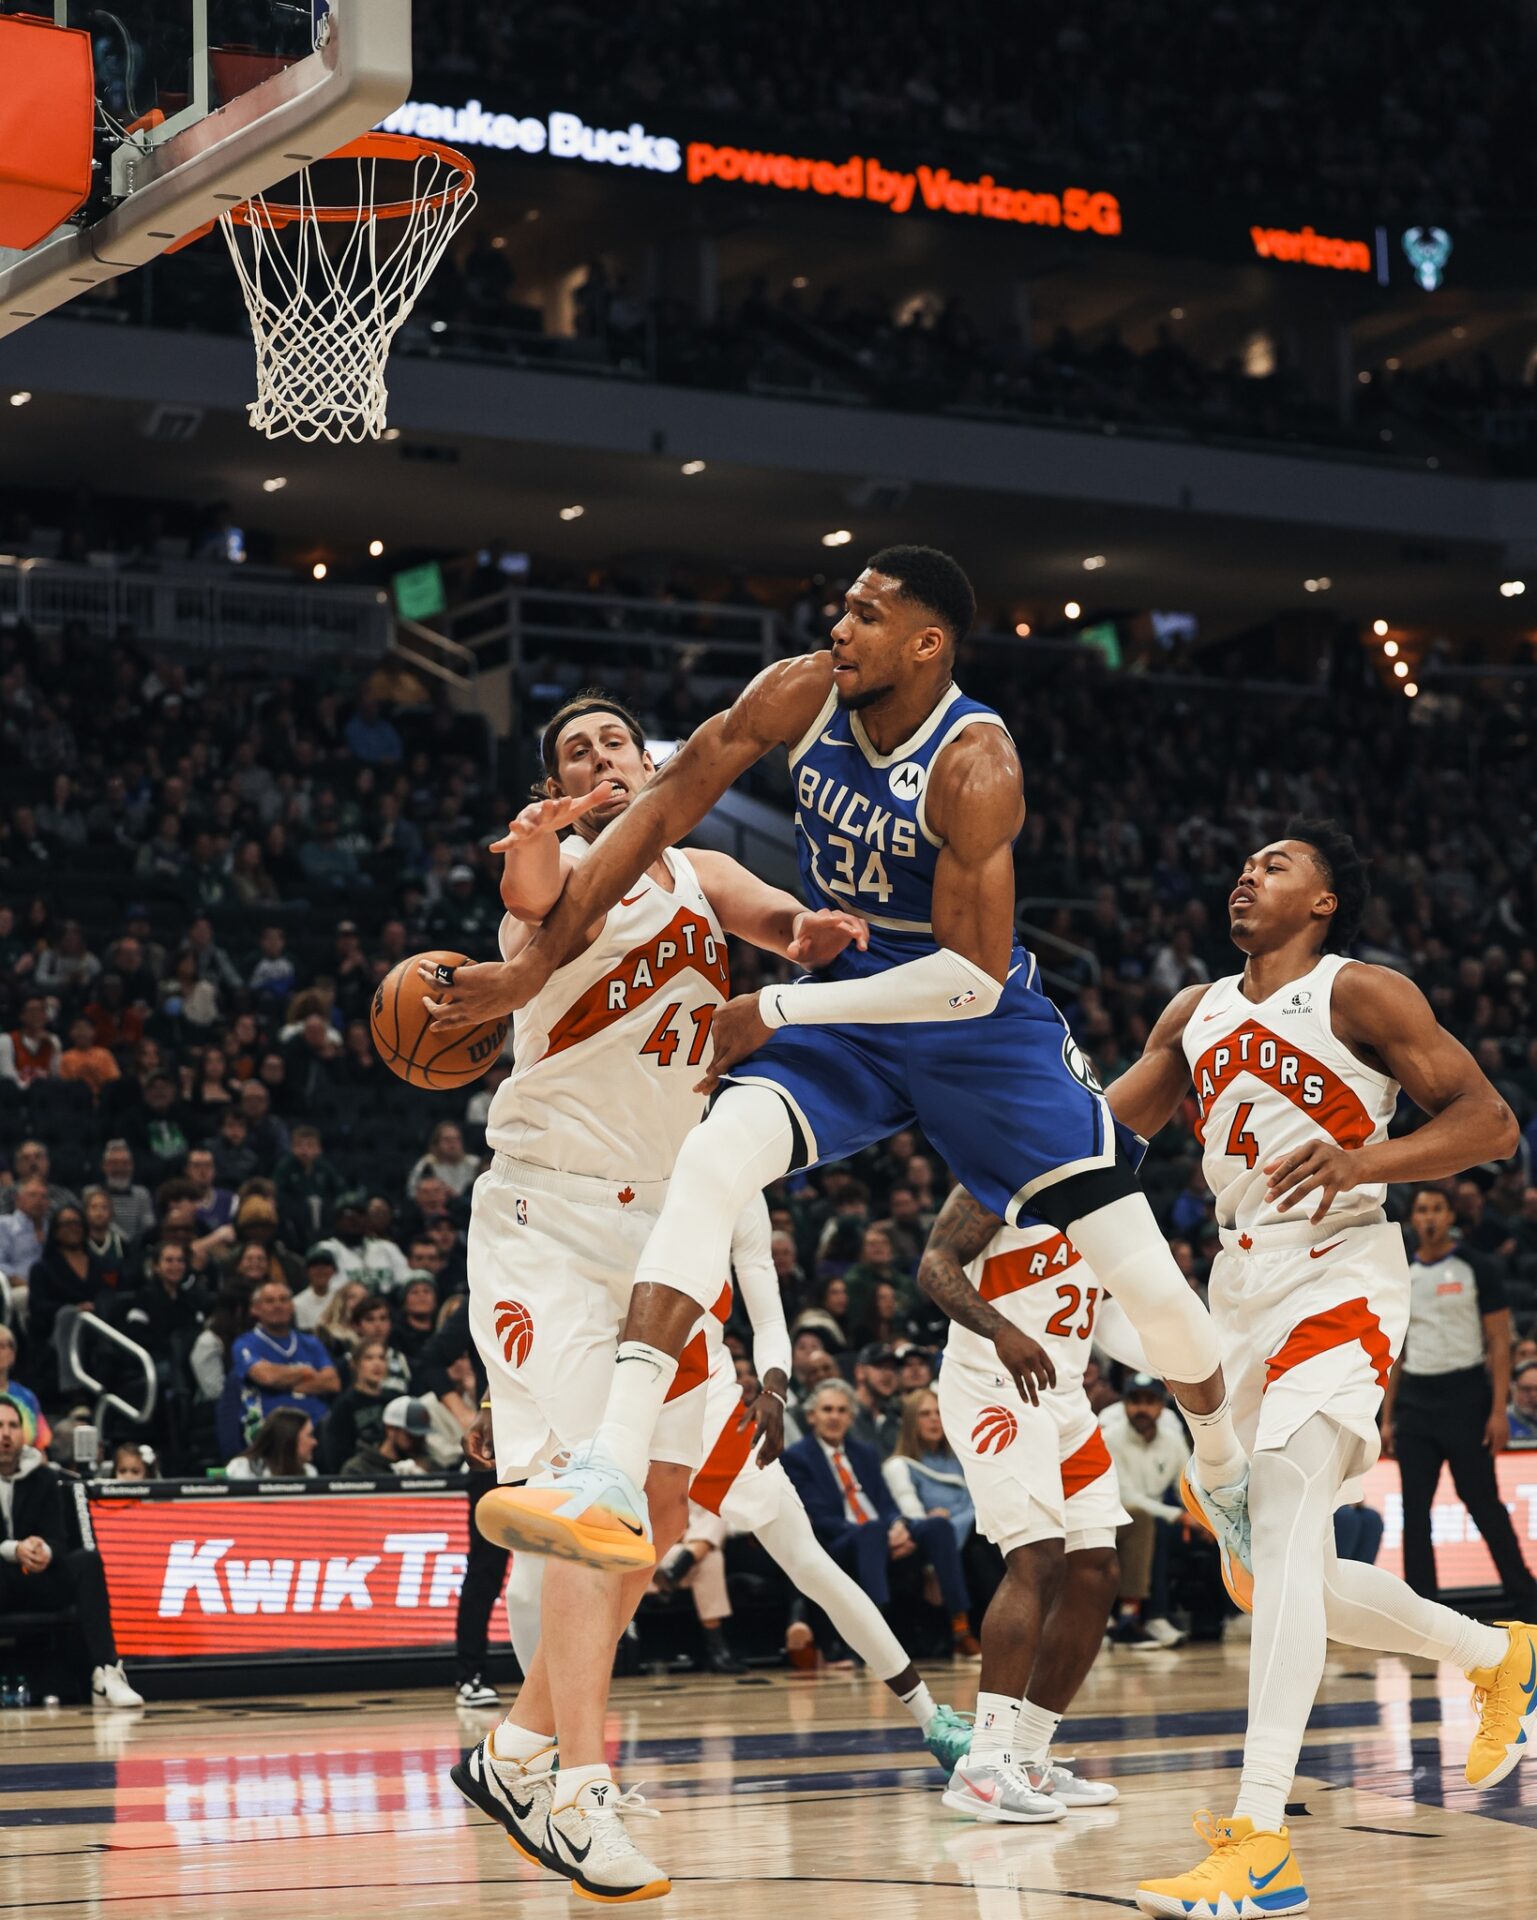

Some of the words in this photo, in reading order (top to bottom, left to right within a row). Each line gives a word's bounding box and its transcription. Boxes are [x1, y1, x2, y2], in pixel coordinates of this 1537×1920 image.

[371, 99, 547, 153] waukee
[549, 111, 682, 172] Bucks
[687, 142, 864, 198] powered
[866, 158, 916, 212] by
[916, 166, 1061, 227] Verizon
[1062, 188, 1122, 235] 5G
[1250, 226, 1370, 272] verizon
[798, 765, 917, 857] BUCKS
[828, 834, 894, 903] 34
[608, 923, 727, 1010] RAPTO
[639, 1002, 718, 1067] 41
[1281, 1008, 1297, 1016] Sun
[1297, 1005, 1313, 1014] Life
[1225, 1103, 1260, 1170] 4
[1028, 1242, 1077, 1277] RA
[1045, 1284, 1098, 1340] 23
[383, 1532, 469, 1608] TR
